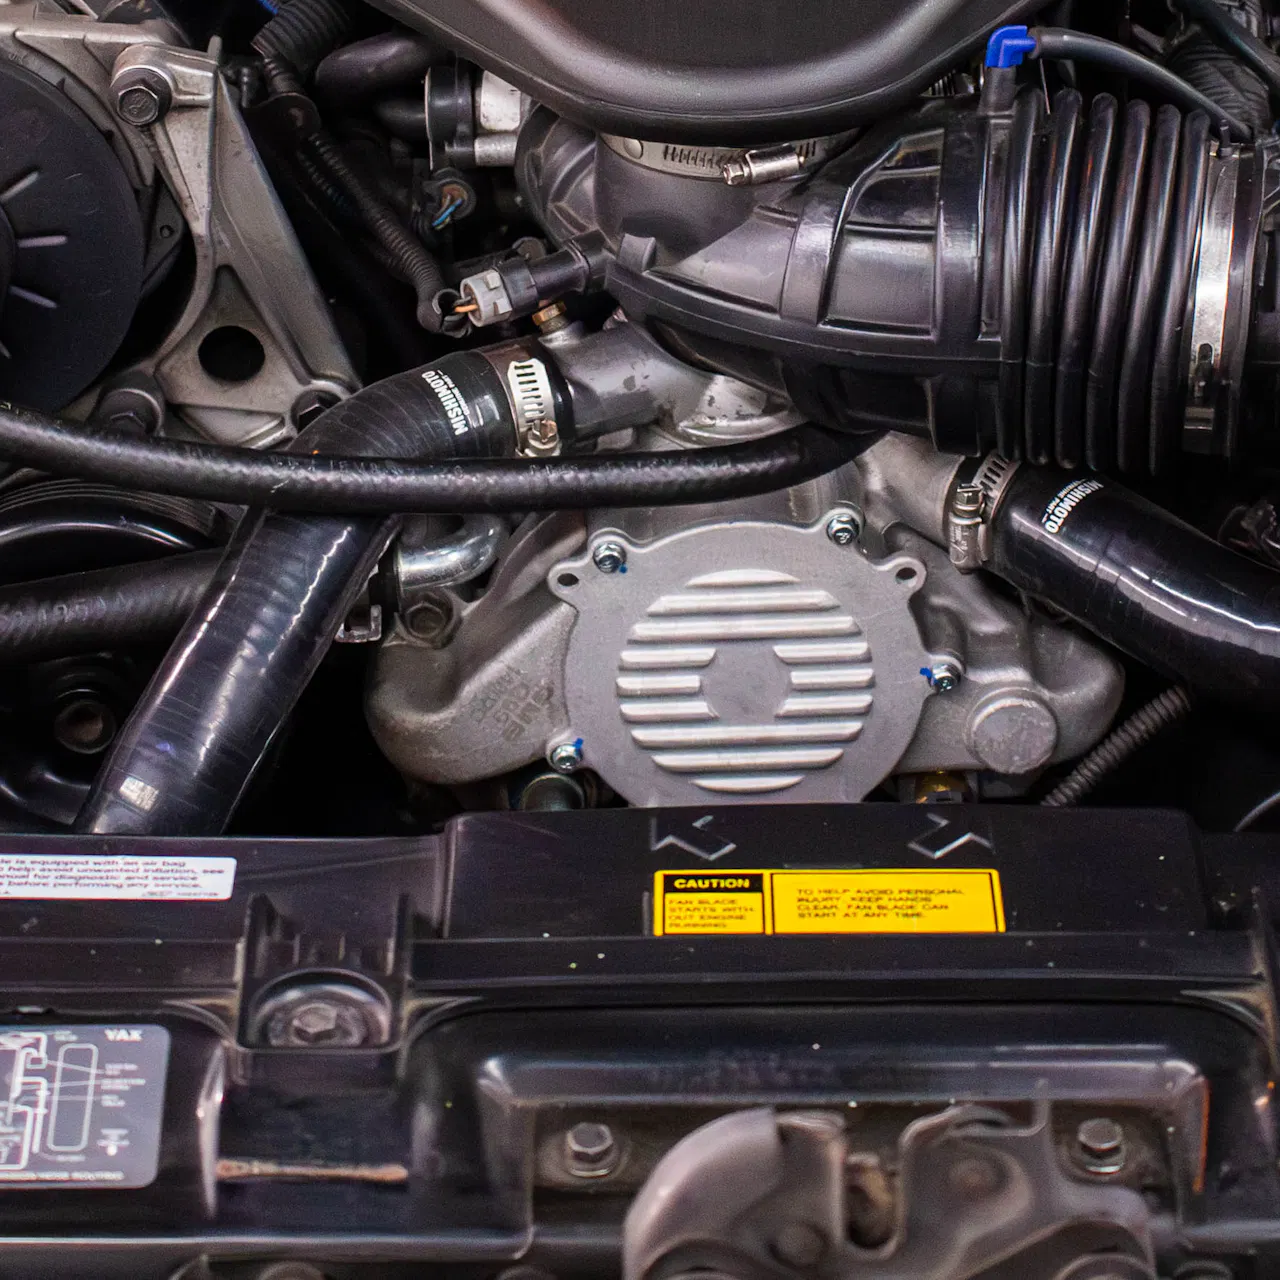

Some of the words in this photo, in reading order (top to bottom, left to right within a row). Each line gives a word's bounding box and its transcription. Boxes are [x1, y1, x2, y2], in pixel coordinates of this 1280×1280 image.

[422, 370, 469, 435] MISHIMOTO
[1044, 480, 1104, 534] MISHIMOTO
[30, 859, 89, 867] equipped
[162, 860, 186, 869] bag
[8, 866, 35, 874] help
[54, 874, 120, 883] diagnostic
[53, 881, 124, 890] performing
[127, 882, 149, 890] any
[673, 877, 751, 890] CAUTION
[898, 888, 965, 896] PERSONAL
[921, 904, 950, 912] CAN
[105, 1028, 143, 1042] VAX
